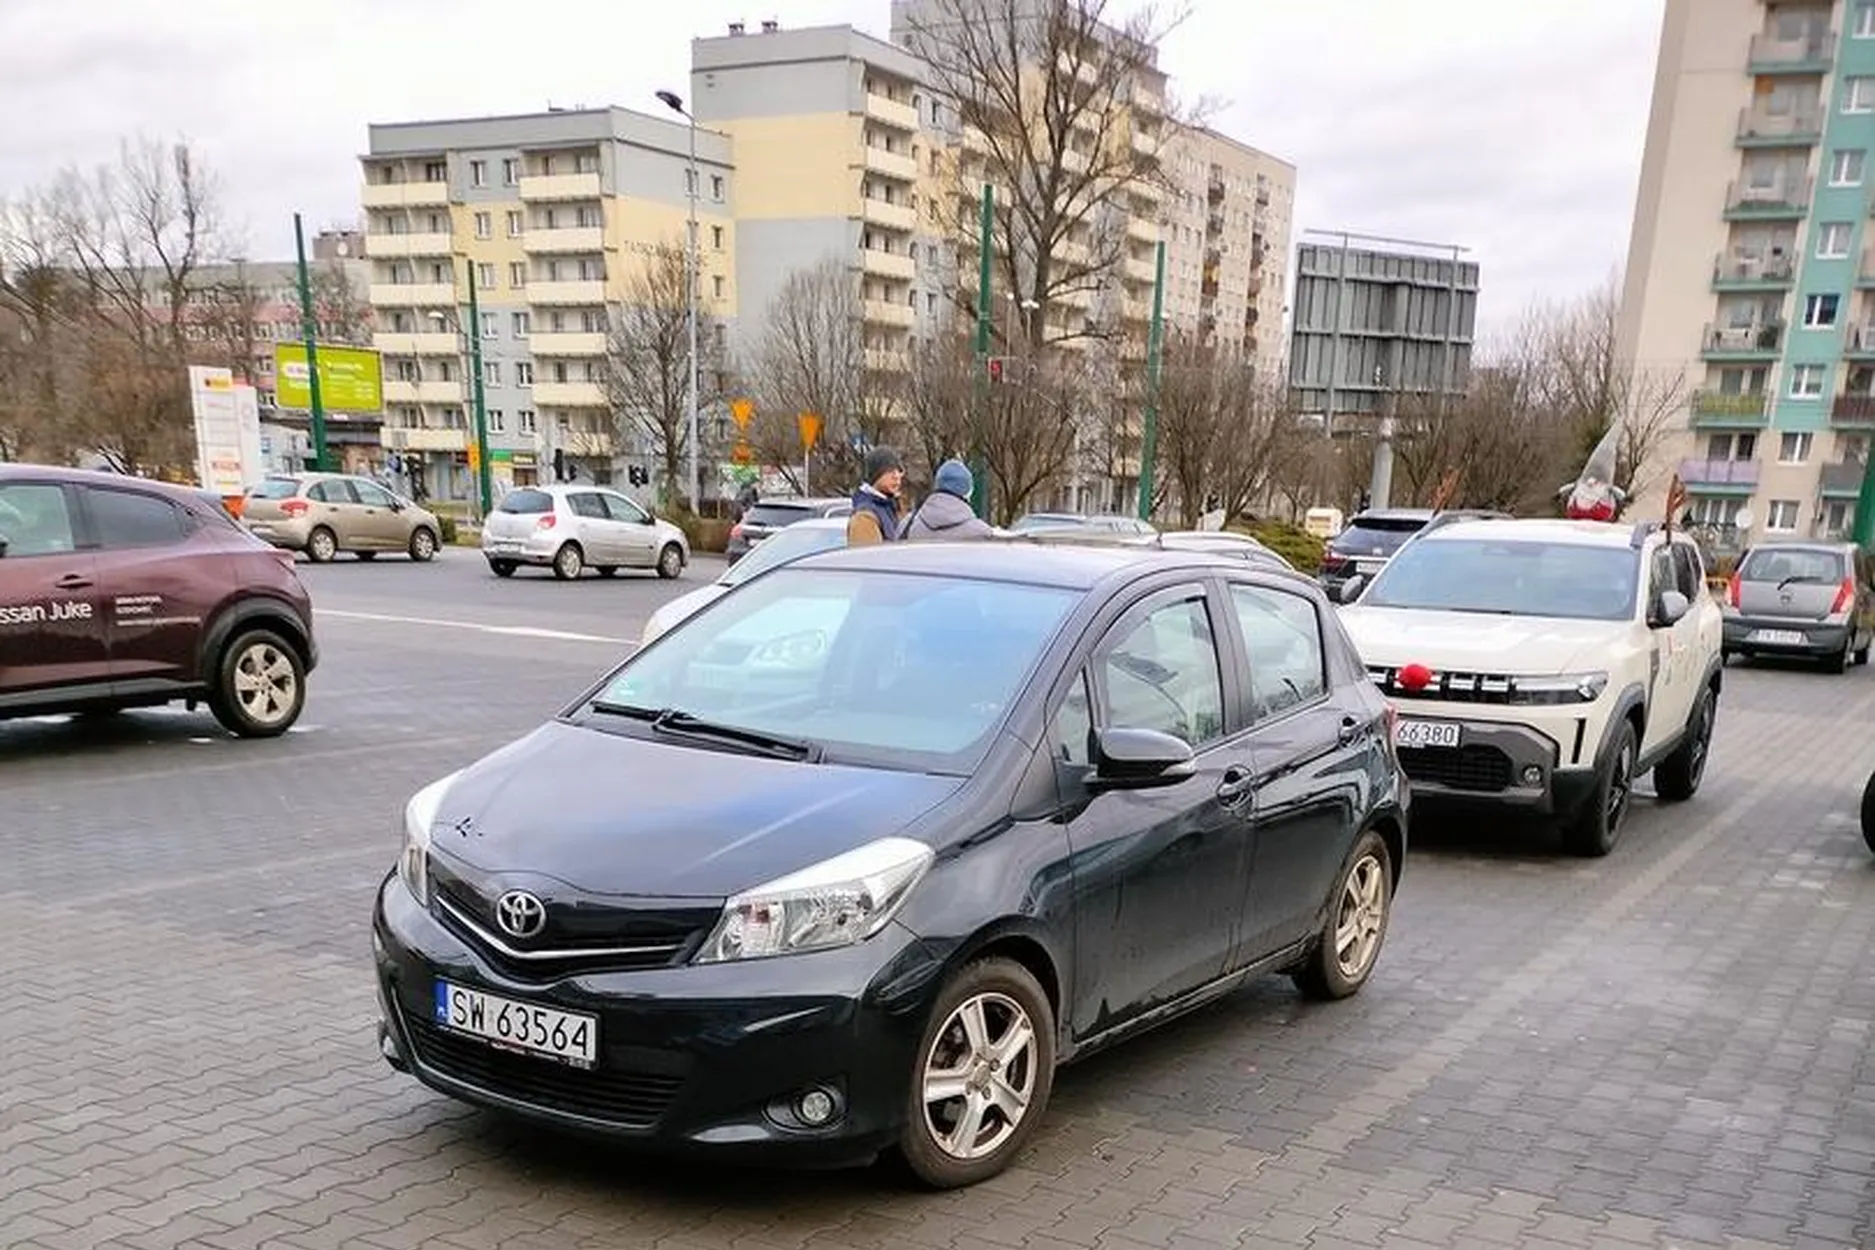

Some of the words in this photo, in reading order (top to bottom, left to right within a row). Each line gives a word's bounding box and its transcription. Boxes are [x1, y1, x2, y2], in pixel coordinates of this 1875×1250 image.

[49, 601, 92, 620] Juke
[1398, 722, 1455, 743] 66380
[452, 990, 485, 1031] SW
[497, 1003, 588, 1056] 63564
